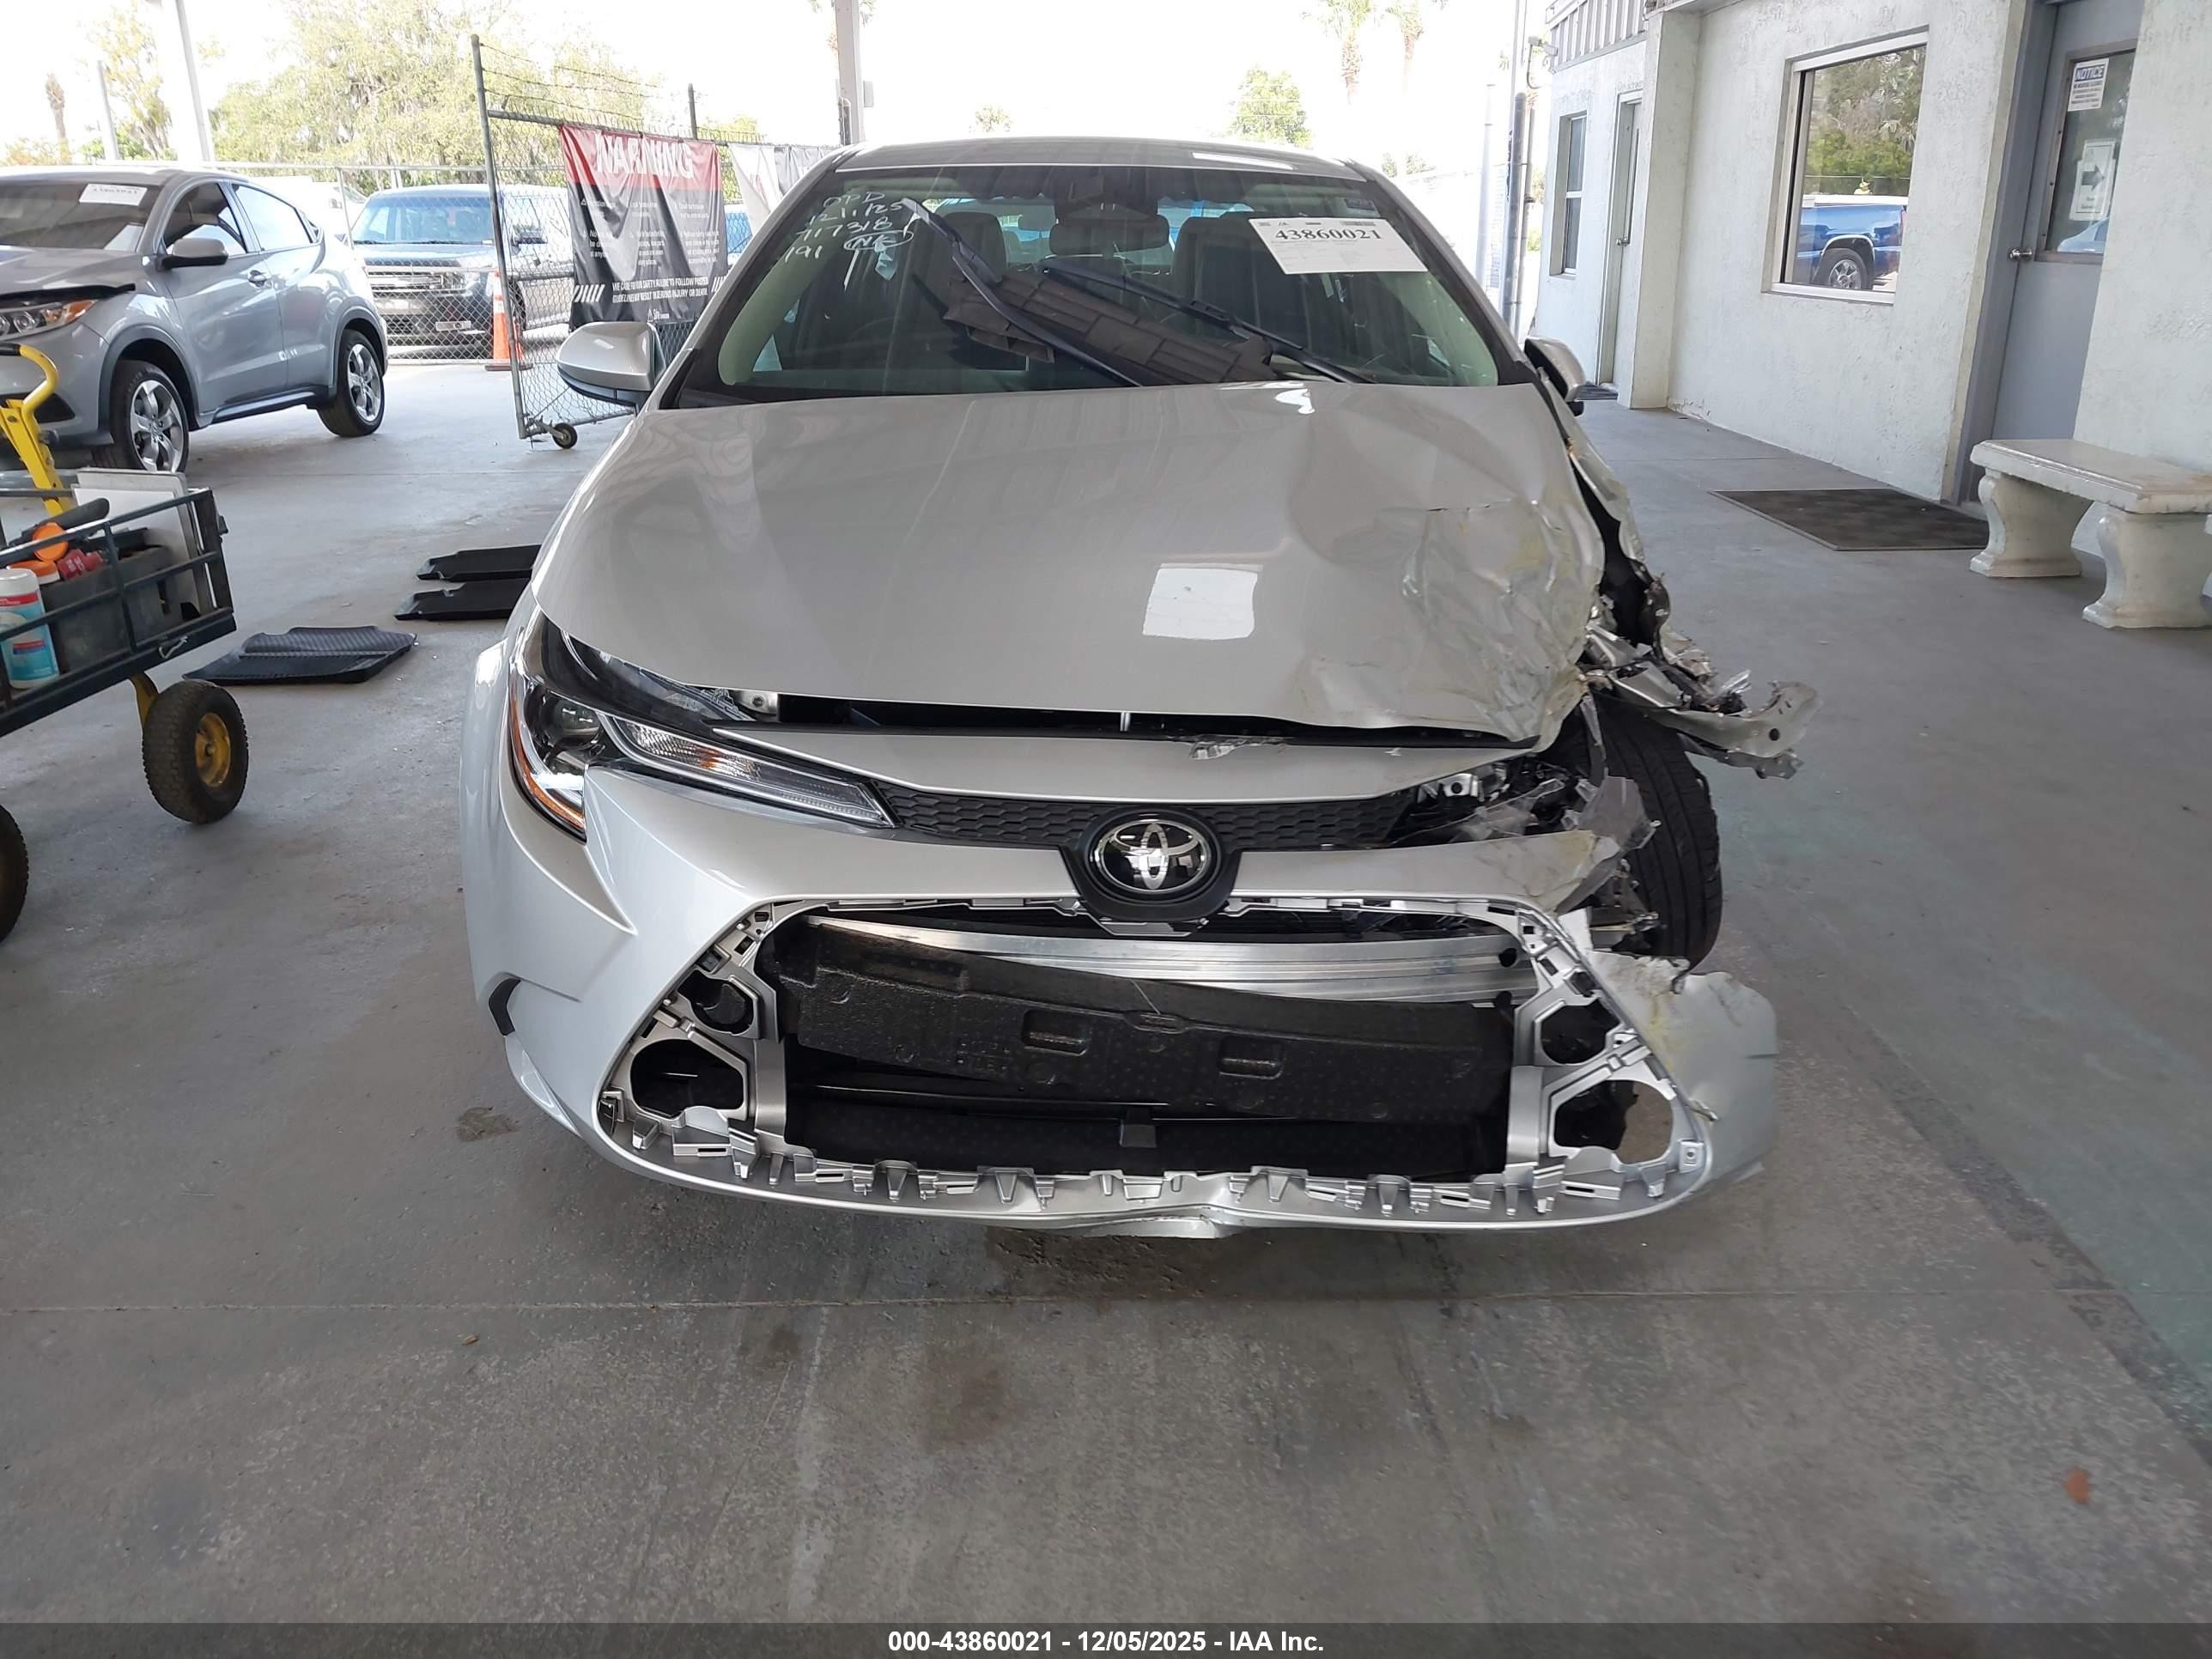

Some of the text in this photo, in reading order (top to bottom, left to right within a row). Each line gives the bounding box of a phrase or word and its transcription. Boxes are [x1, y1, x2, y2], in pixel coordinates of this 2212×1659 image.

[2075, 66, 2104, 80] NOTICE
[1275, 228, 1382, 240] 43860021
[675, 276, 694, 286] FOLLOW
[672, 289, 688, 298] INJURY
